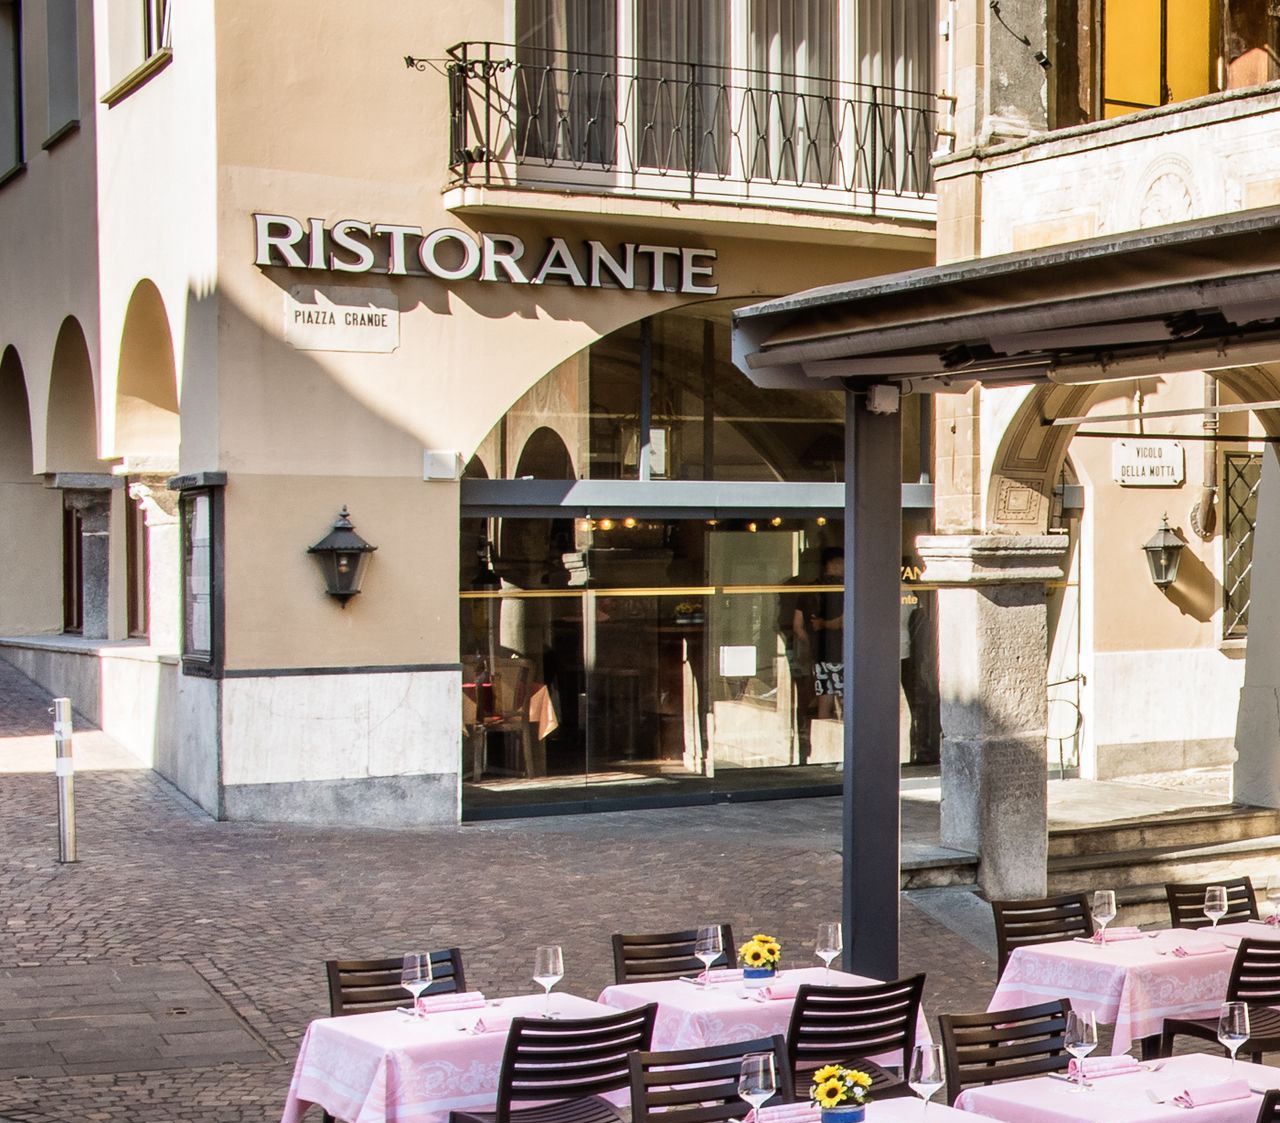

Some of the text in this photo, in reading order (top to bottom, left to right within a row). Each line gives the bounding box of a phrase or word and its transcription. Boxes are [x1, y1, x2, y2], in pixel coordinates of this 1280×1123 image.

[253, 213, 719, 295] RISTORANTE
[295, 310, 388, 328] PIAZZA GRANDE
[1136, 447, 1163, 458] VICOLO
[1121, 465, 1175, 477] DELLA MOTTA
